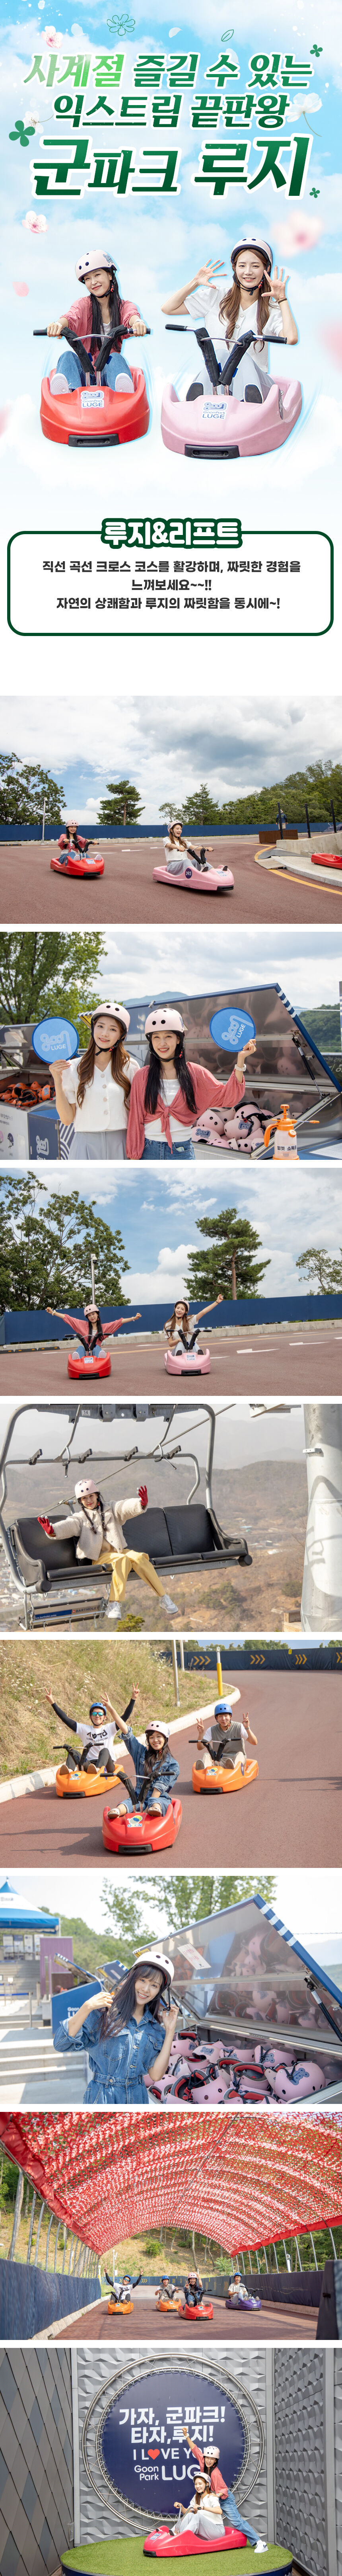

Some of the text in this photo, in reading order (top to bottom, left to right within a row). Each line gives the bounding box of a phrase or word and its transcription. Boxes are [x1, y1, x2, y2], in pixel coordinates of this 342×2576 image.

[236, 1024, 246, 1038] LUGE
[119, 2406, 225, 2426] 가자, 군파크!
[133, 2449, 136, 2460] I
[140, 2473, 159, 2481] Park
[161, 2464, 201, 2481] LUG
